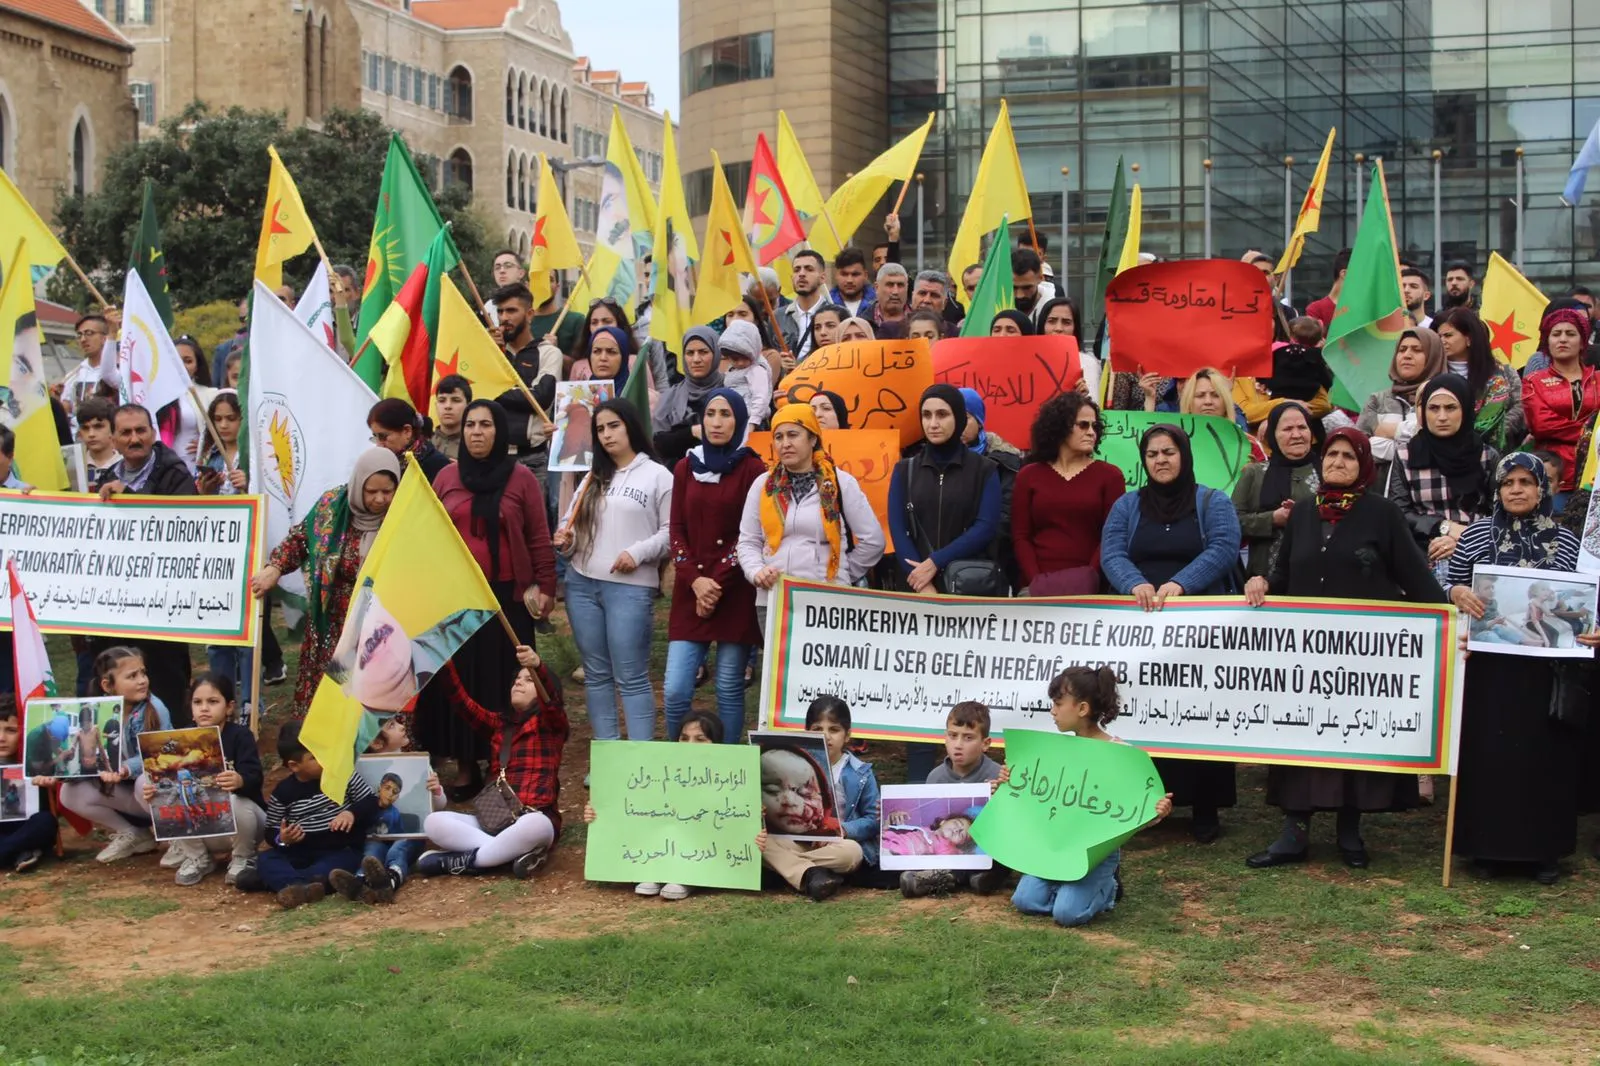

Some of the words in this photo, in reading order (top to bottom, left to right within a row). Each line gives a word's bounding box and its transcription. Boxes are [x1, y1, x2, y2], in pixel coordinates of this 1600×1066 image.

[1151, 282, 1216, 309] مقاومة
[862, 346, 915, 378] قتل
[623, 486, 648, 509] EAGLE
[107, 521, 136, 542] XWE
[140, 515, 164, 543] YÊN
[166, 514, 209, 544] DÎROKÎ
[211, 520, 226, 543] YE
[228, 521, 241, 544] DI
[87, 549, 105, 577] ÊN
[106, 554, 122, 577] KU
[125, 552, 154, 582] ŞERÎ
[156, 554, 202, 581] TERORÊ
[202, 557, 235, 581] KIRIN
[167, 590, 196, 623] الدولي
[198, 592, 234, 619] المجتمع
[805, 605, 919, 636] DAGIRKERIYA
[923, 613, 998, 641] TURKIYÊ
[1001, 620, 1017, 642] LI
[1021, 619, 1056, 645] SER
[1060, 619, 1104, 647] GELÊ
[1106, 624, 1156, 650] KURD,
[1162, 625, 1297, 654] BERDEWAMIYA
[1302, 628, 1423, 659] KOMKUJIYÊN
[802, 641, 872, 671] OSMANÎ
[874, 647, 889, 672] LI
[893, 649, 927, 675] SER
[931, 650, 988, 679] GELÊN
[992, 654, 1063, 682] HERÊMÊ
[1139, 661, 1208, 693] ERMEN,
[1214, 667, 1287, 694] SURYAN
[1292, 664, 1304, 693] Û
[1309, 668, 1404, 699] AŞÛRIYAN
[1409, 674, 1420, 699] E
[850, 680, 892, 710] والسريان
[1170, 700, 1213, 728] استمرار
[1215, 712, 1230, 729] هو
[1232, 703, 1269, 737] الكردي
[1272, 704, 1314, 732] الشعب
[1316, 708, 1340, 736] على
[1342, 708, 1378, 743] التركي
[1380, 711, 1421, 738] العدوان
[674, 766, 712, 787] الدولية
[714, 767, 746, 791] المؤامرة
[1007, 757, 1066, 821] إرهابي
[624, 797, 676, 818] شمسنا
[1062, 769, 1155, 826] أردوغان
[676, 809, 709, 825] حجب
[713, 797, 751, 830] تستطيع
[622, 838, 675, 865] الحرية
[680, 841, 718, 863] لدرب
[725, 843, 753, 868] المنيرة
